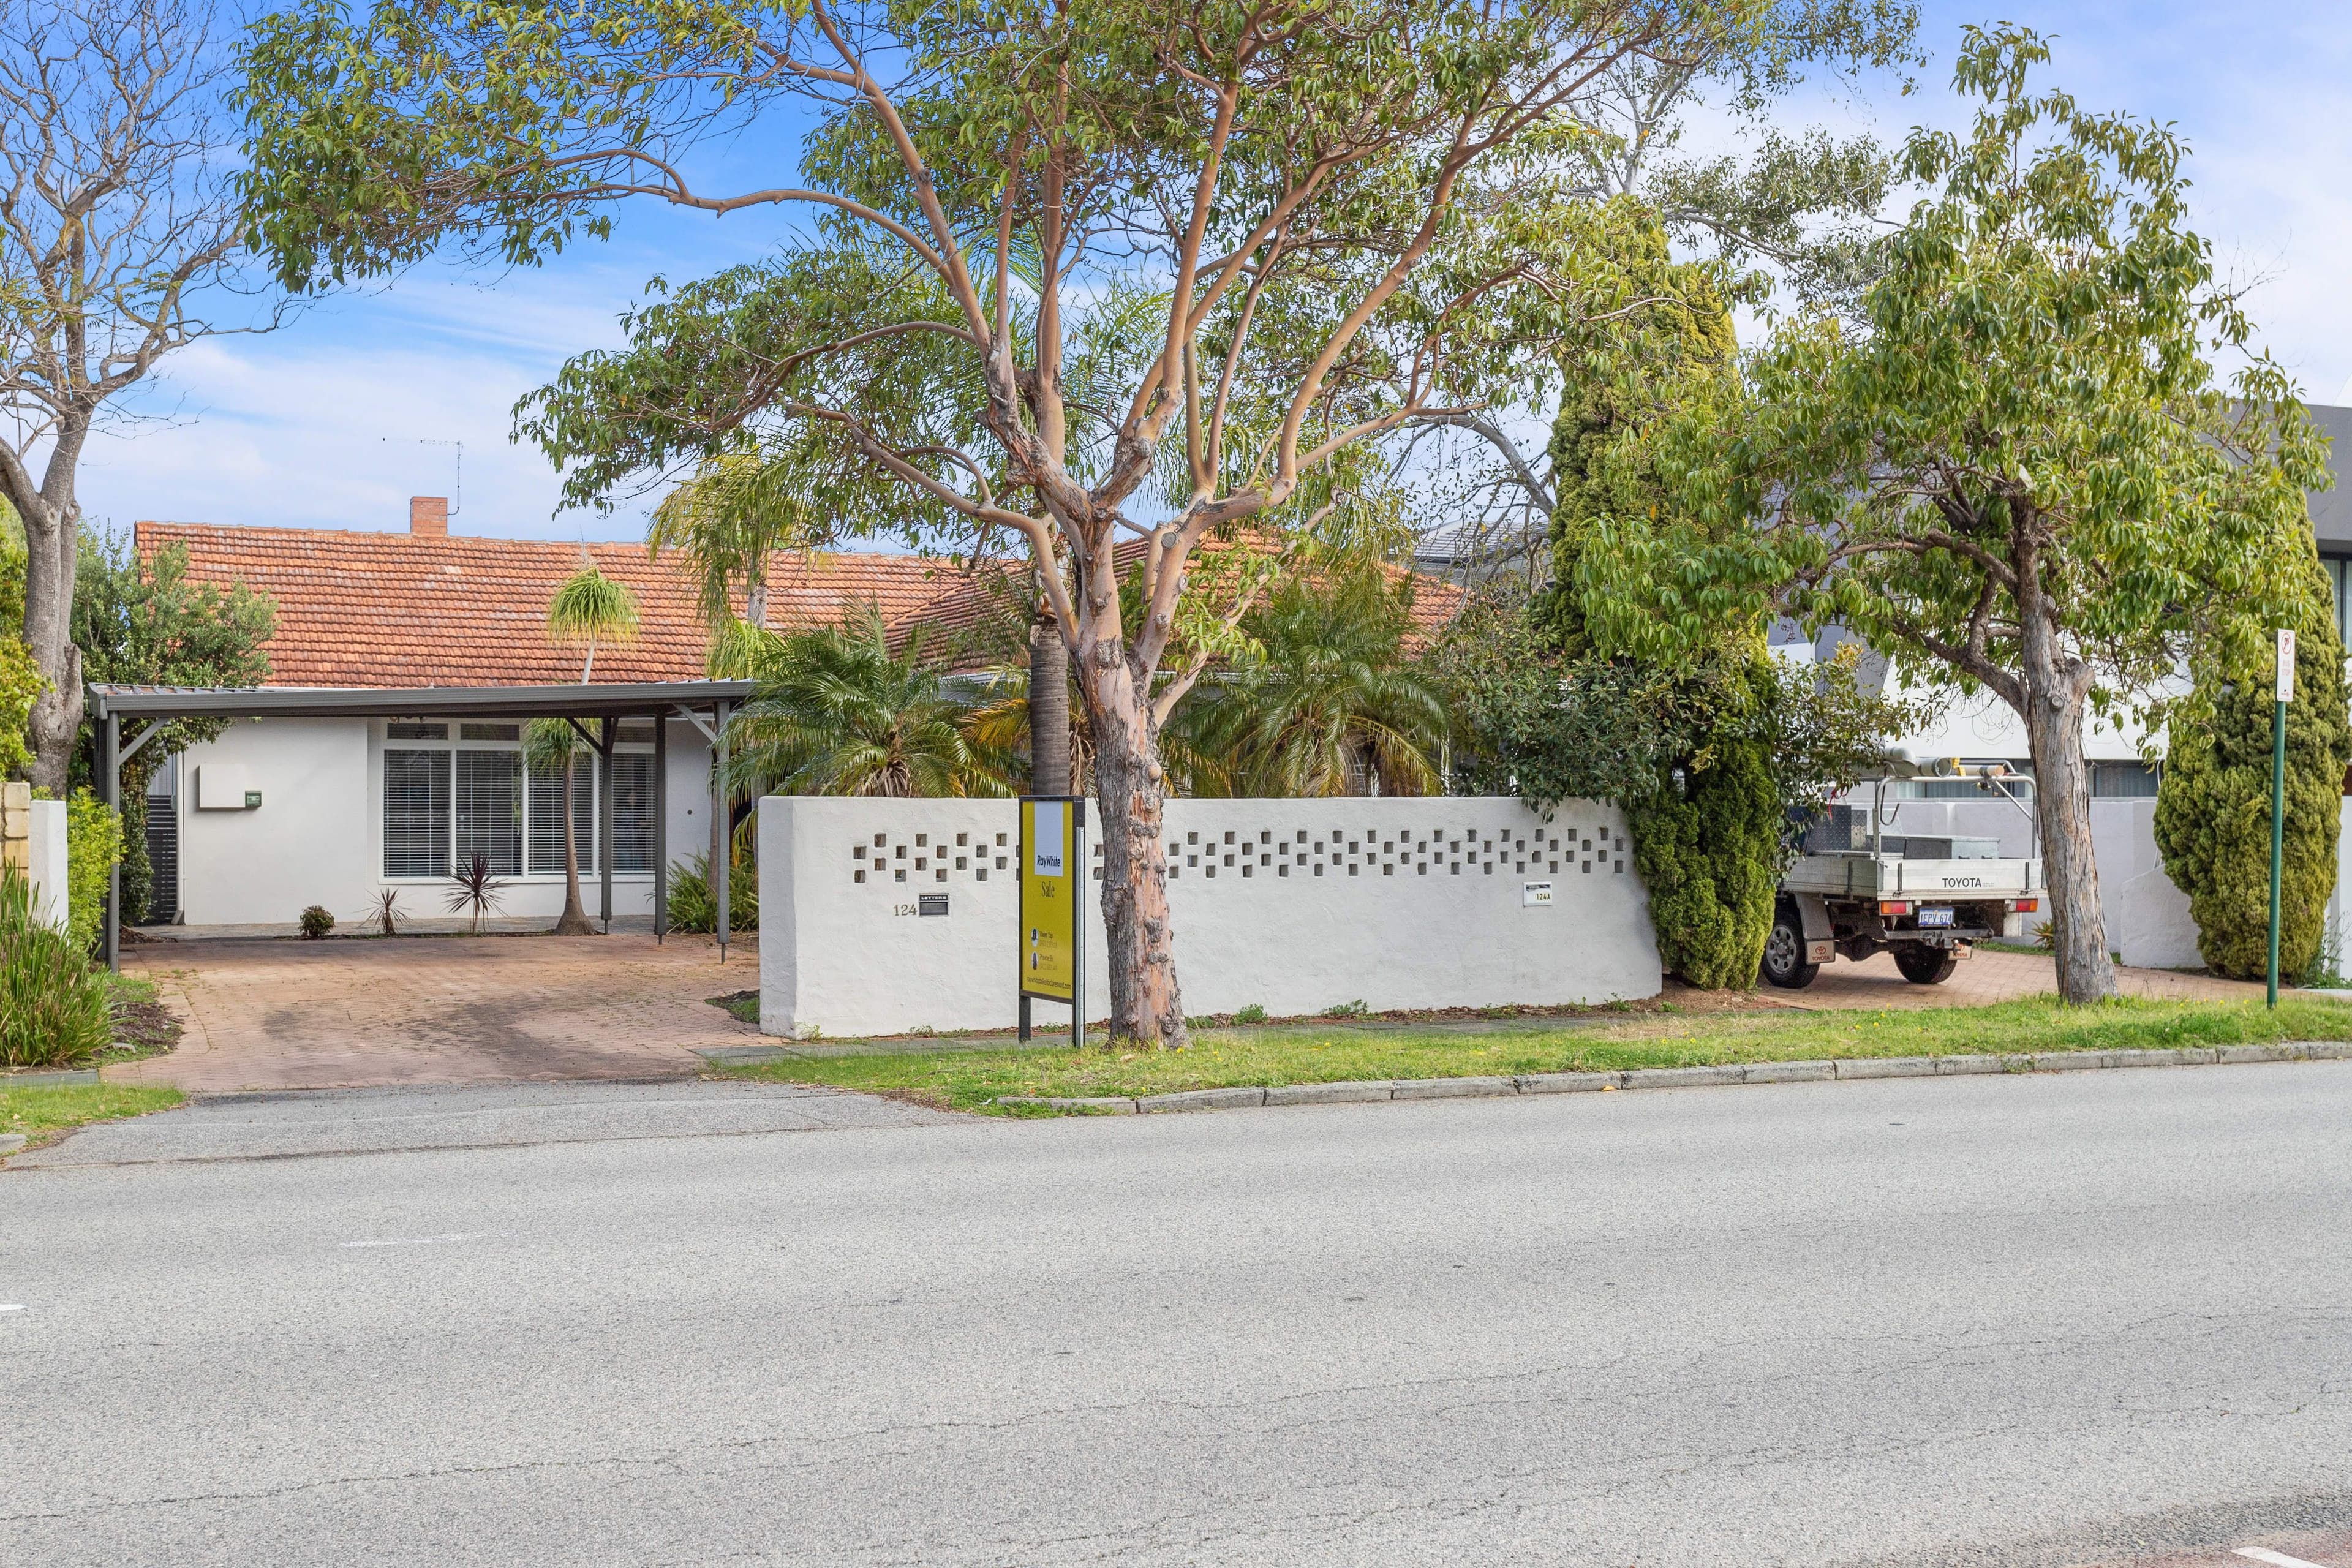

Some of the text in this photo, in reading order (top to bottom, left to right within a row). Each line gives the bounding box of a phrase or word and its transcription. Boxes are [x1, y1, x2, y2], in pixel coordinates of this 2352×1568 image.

[1037, 855, 1061, 868] RayWhite
[1041, 881, 1055, 898] Sale
[1942, 878, 1981, 888] TOYOTA
[894, 903, 917, 916] 124
